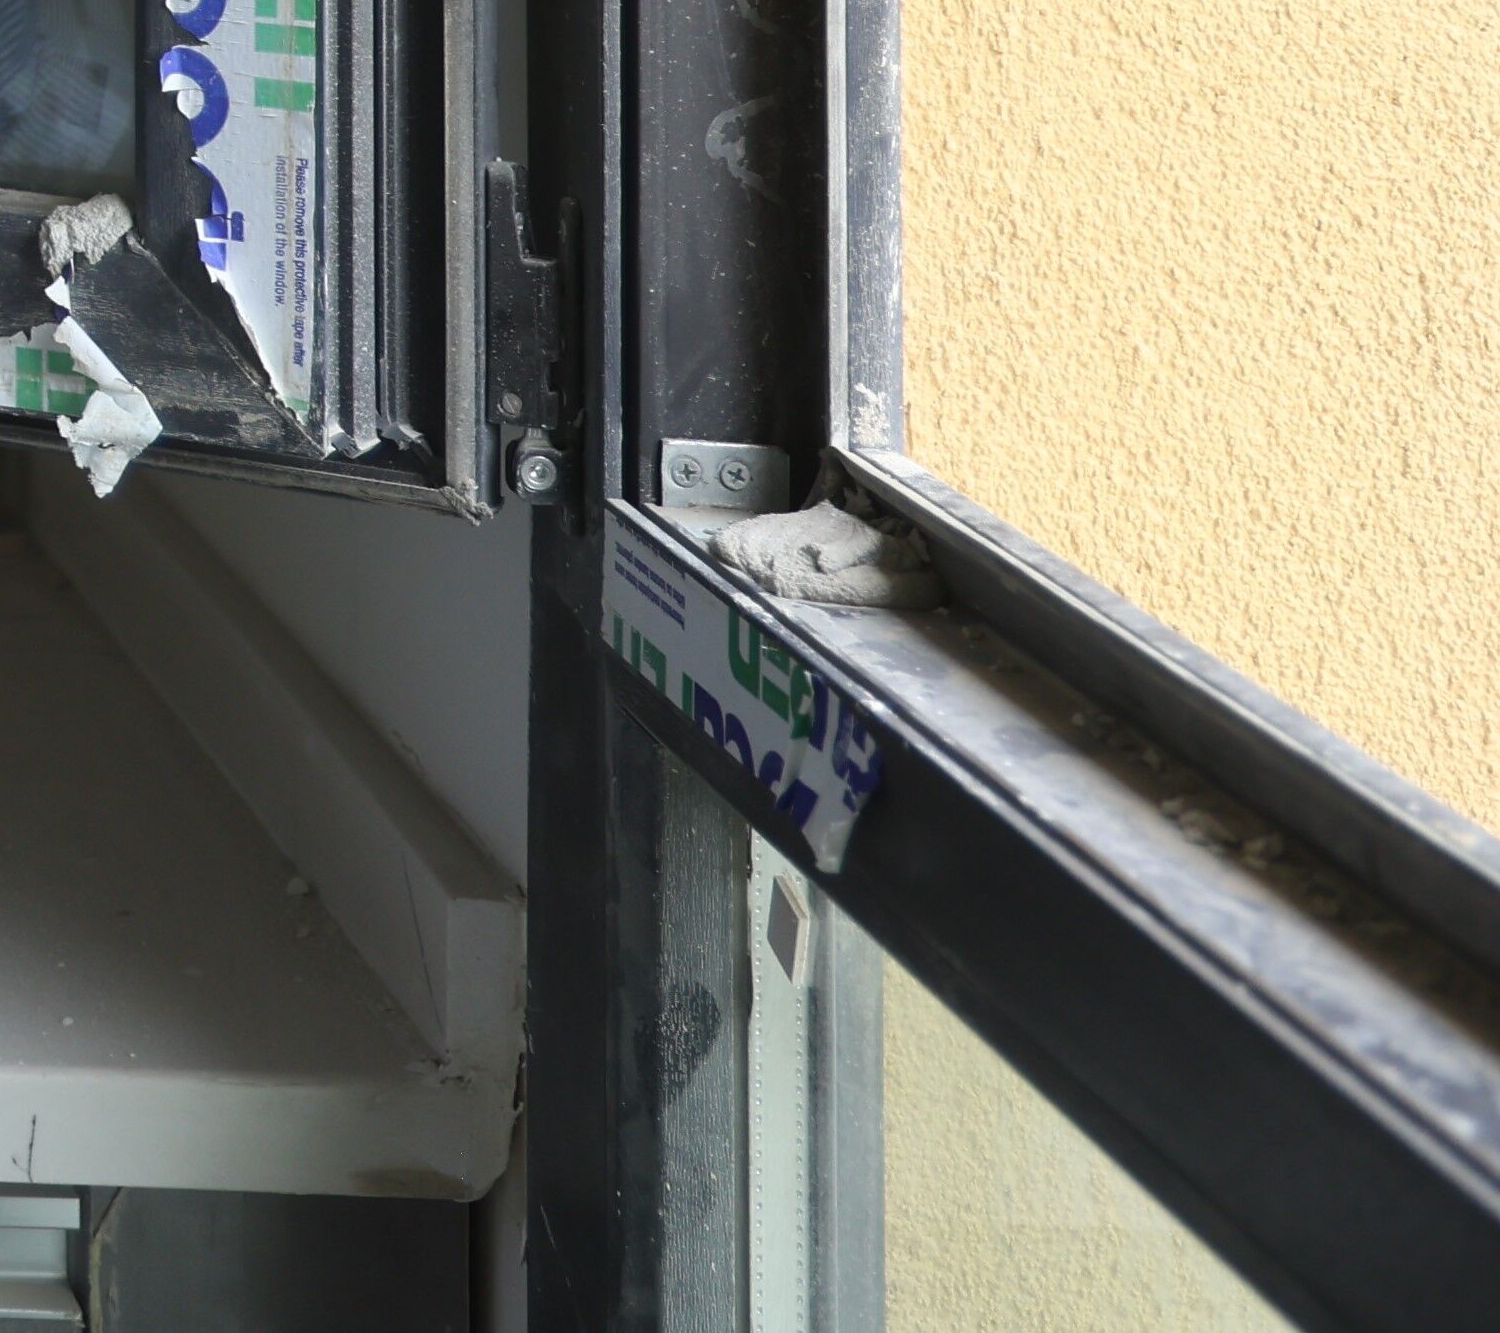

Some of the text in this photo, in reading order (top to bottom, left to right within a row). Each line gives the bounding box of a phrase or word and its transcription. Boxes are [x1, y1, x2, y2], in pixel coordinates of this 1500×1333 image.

[274, 155, 288, 307] installation of the window.
[295, 239, 308, 258] this
[293, 260, 307, 313] protective
